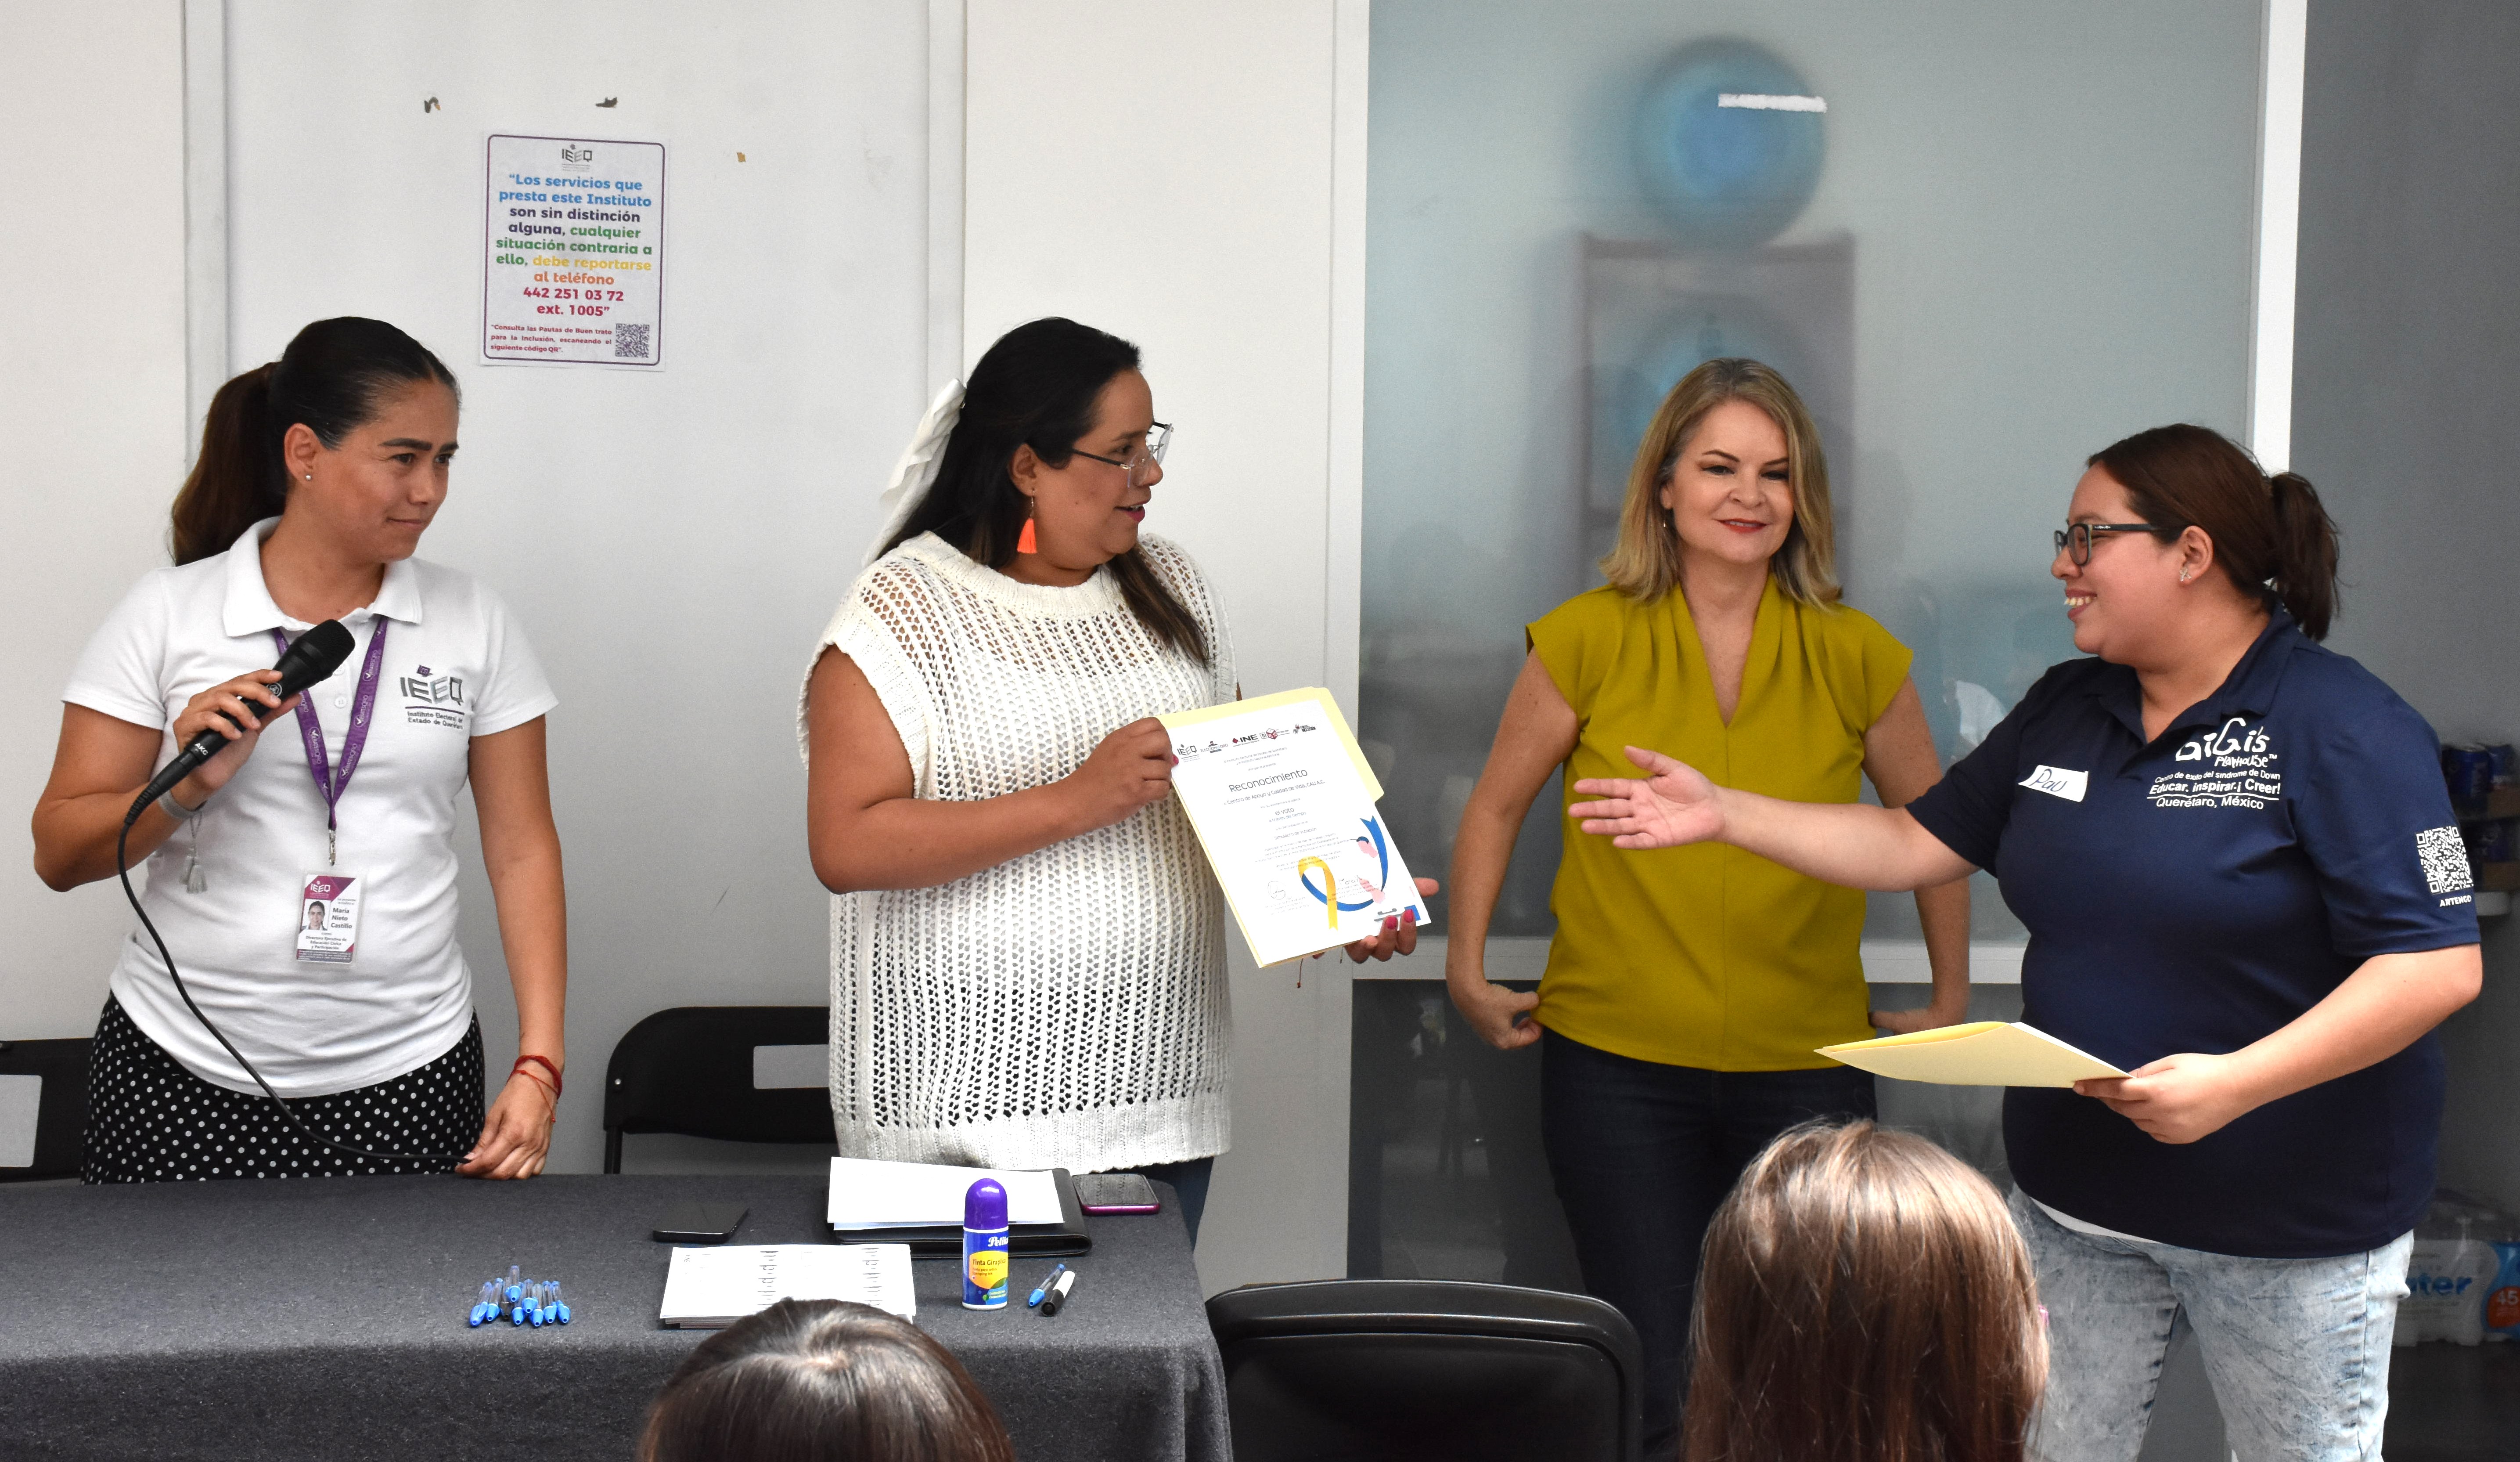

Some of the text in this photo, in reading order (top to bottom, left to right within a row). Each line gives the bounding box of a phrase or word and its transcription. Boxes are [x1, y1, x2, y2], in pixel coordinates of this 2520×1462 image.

[546, 177, 610, 188] servicios
[615, 181, 642, 192] que
[500, 191, 651, 206] presta este Instituto
[510, 207, 640, 222] son sin distinción
[509, 222, 641, 239] alguna, cualquier
[497, 237, 652, 255] situación contraria a
[497, 254, 651, 270] ello, debe reportarse
[534, 271, 614, 285] al teléfono
[524, 287, 623, 301] 442 251 03 72
[537, 305, 563, 314] ext.
[1240, 734, 1258, 743] INE
[1228, 770, 1308, 792] Reconocimiento
[2261, 770, 2280, 780] Down
[2156, 796, 2264, 809] Querétaro, México
[2440, 895, 2472, 907] ARTENGO
